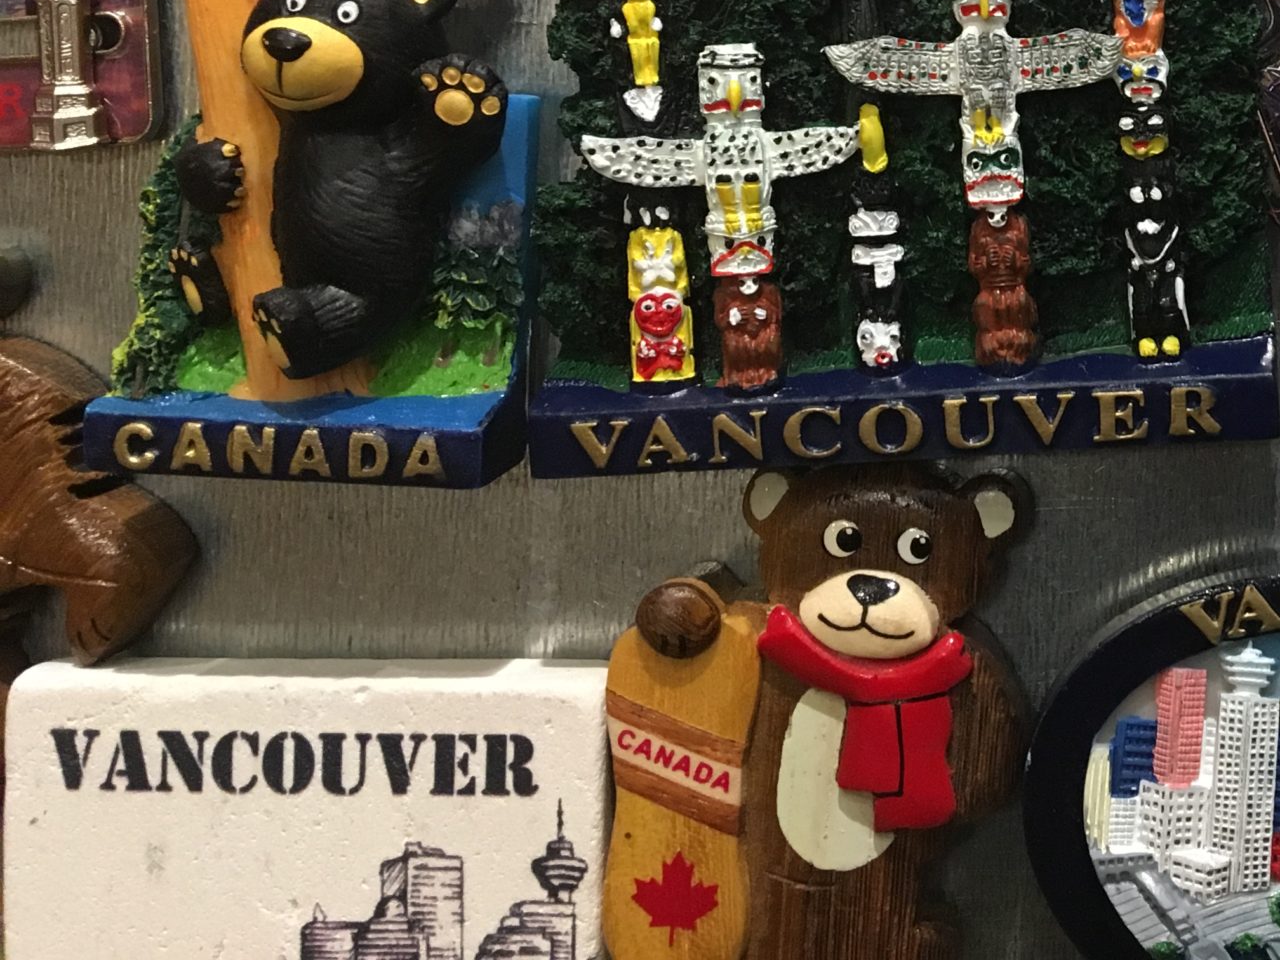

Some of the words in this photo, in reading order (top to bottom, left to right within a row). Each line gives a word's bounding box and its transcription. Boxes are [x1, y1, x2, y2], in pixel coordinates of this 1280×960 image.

[112, 422, 447, 480] CANADA
[569, 387, 1222, 469] VANCOUVER
[51, 728, 539, 796] VANCOUVER
[616, 729, 731, 795] CANADA
